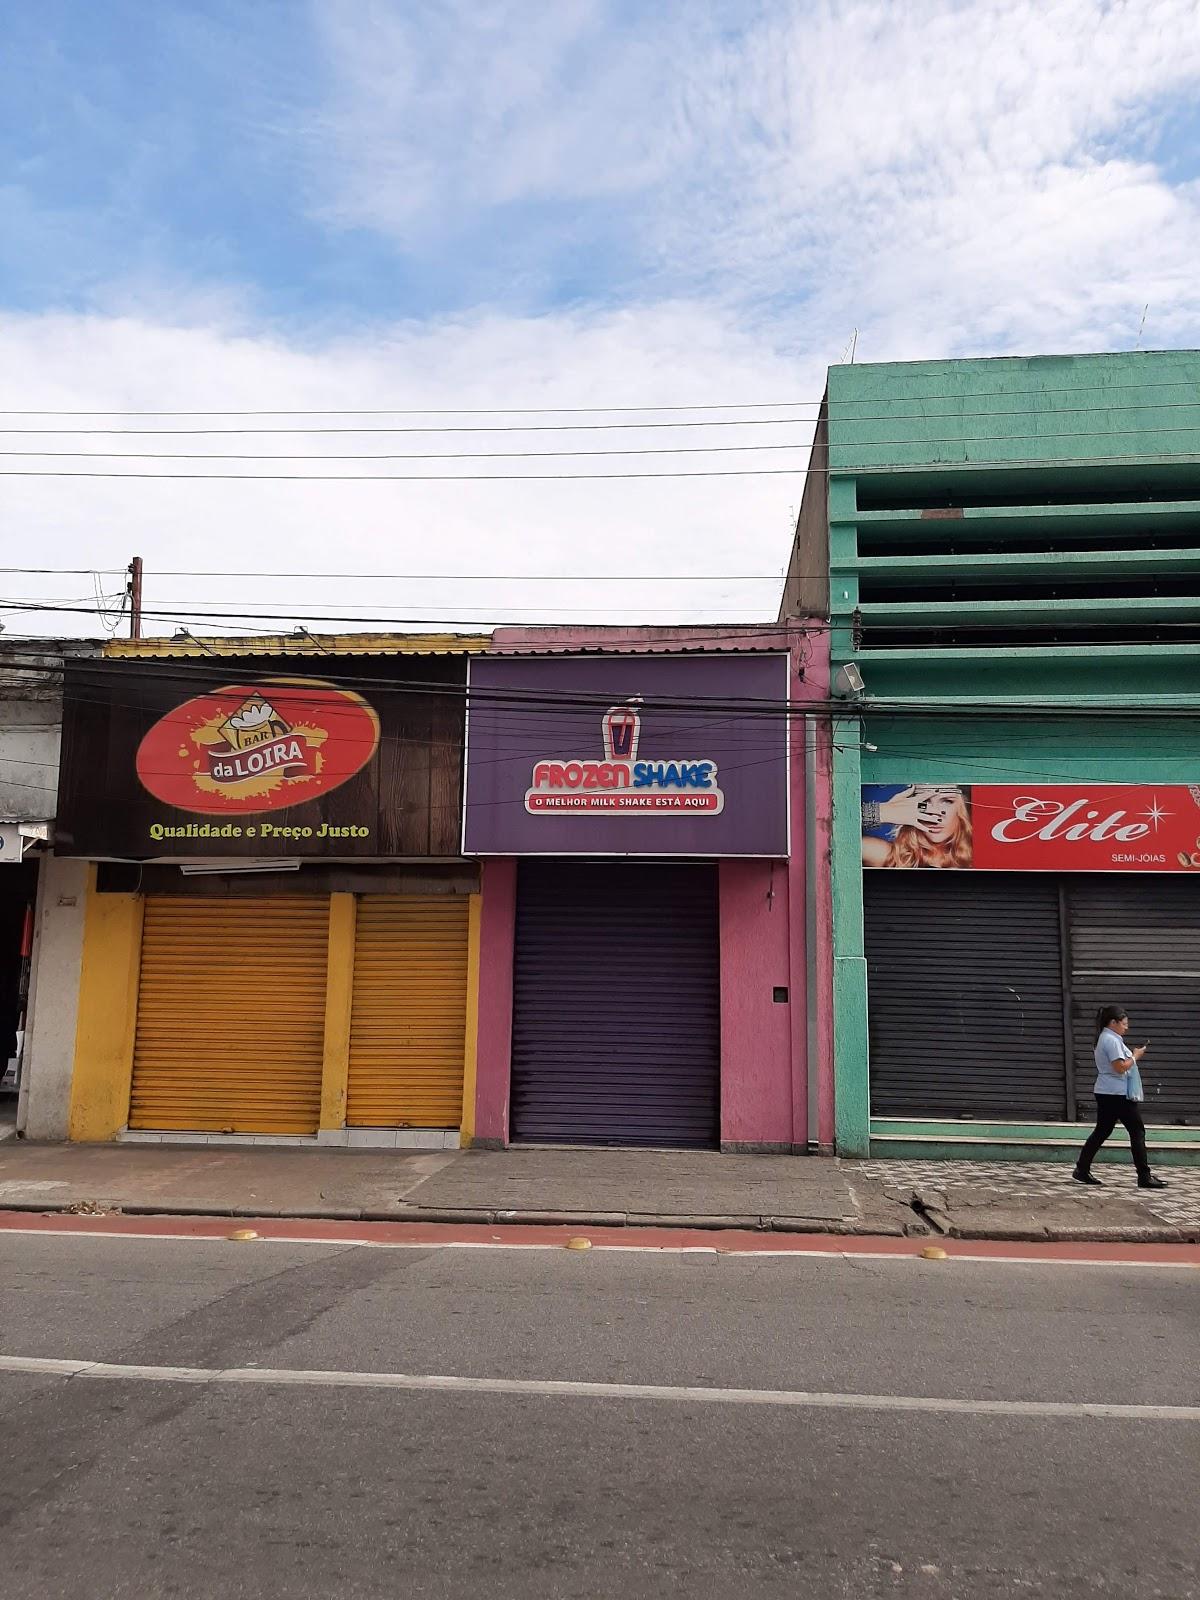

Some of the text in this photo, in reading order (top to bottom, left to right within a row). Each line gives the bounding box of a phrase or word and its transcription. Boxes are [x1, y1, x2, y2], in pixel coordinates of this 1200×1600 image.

[243, 731, 270, 747] BAR
[213, 742, 303, 778] da LOIRA
[535, 763, 713, 788] FROZEN SHAKE
[546, 798, 587, 806] MELHOR
[590, 799, 616, 807] MILK
[619, 799, 652, 807] SHAKE
[684, 799, 709, 808] AQUI
[990, 796, 1151, 843] Elite
[150, 823, 370, 840] Qualidade e Preço Justo
